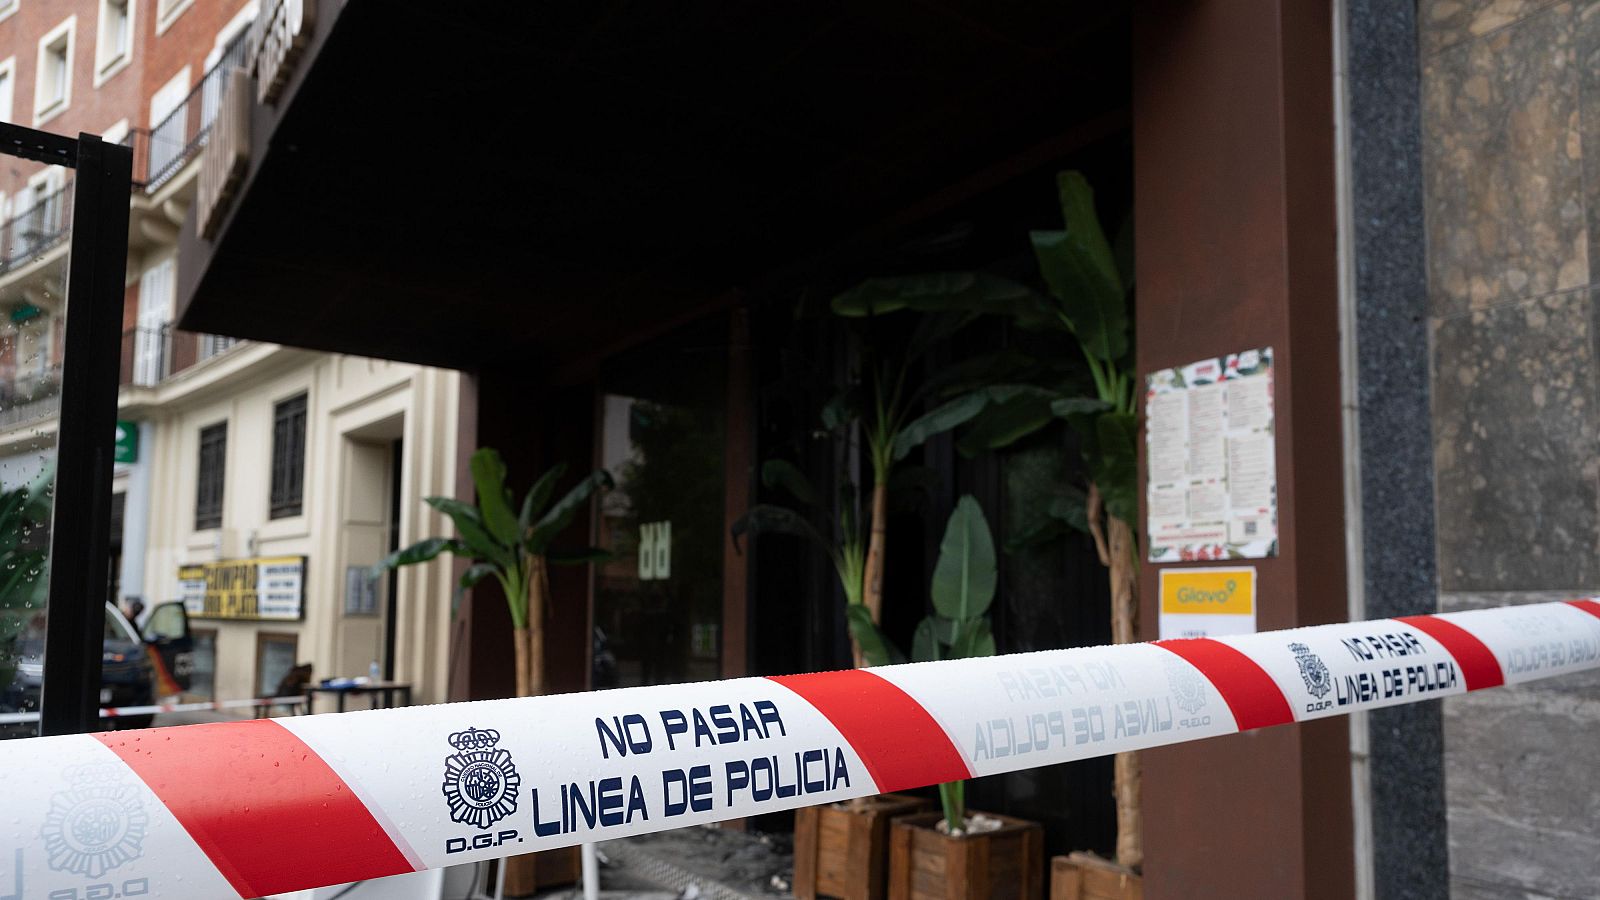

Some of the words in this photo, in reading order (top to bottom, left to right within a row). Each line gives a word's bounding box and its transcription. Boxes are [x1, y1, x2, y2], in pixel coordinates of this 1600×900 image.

[1340, 638, 1374, 662] NO
[1366, 632, 1426, 658] PASAR
[1334, 672, 1379, 706] LINEA
[1382, 668, 1403, 698] DE
[1406, 662, 1457, 695] POLICIA
[1306, 700, 1334, 713] D.G.P.
[595, 713, 653, 759] NO
[659, 700, 787, 750] PASAR
[532, 774, 649, 837] LINEA
[662, 764, 713, 817] DE
[725, 746, 851, 807] POLICIA
[446, 830, 523, 854] D.G.P.
